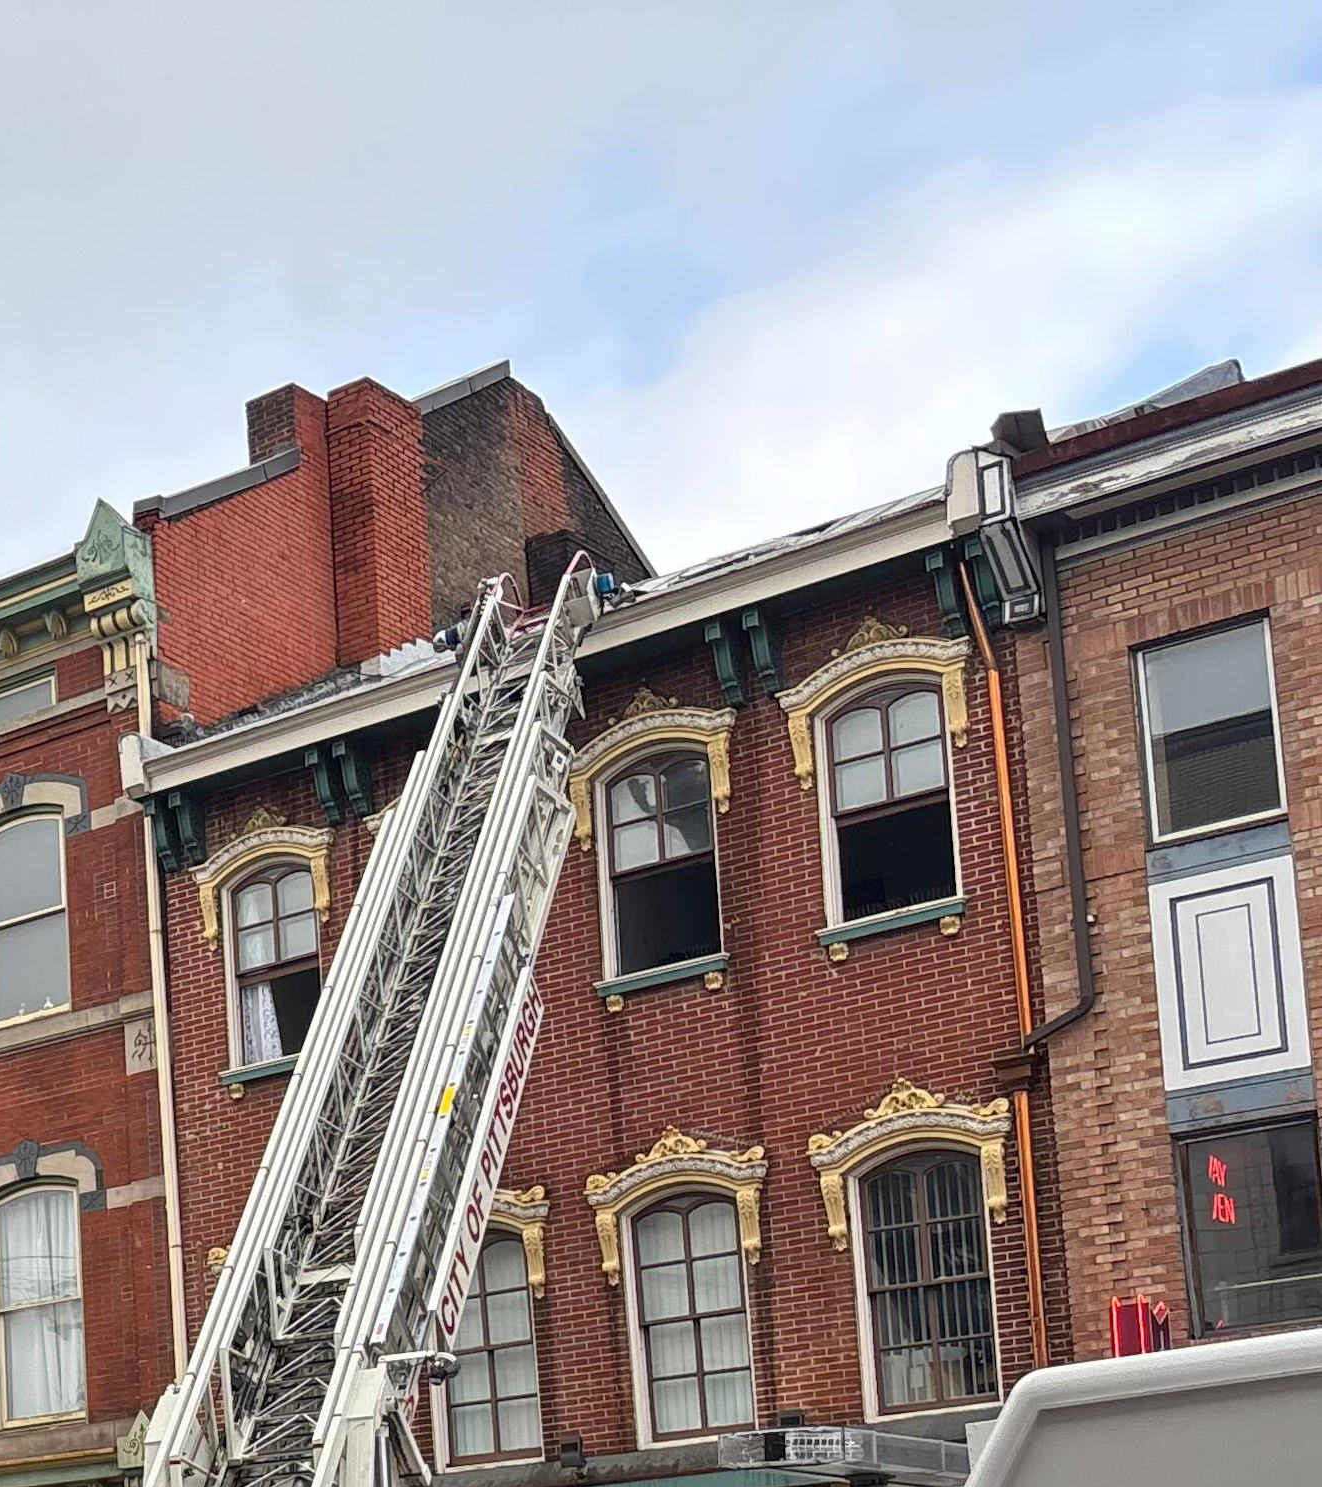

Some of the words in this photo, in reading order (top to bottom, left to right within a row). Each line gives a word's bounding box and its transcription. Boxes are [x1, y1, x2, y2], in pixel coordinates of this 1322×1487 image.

[441, 1236, 471, 1336] CITY
[466, 1179, 484, 1243] OF
[480, 978, 543, 1191] PITTSBURGH
